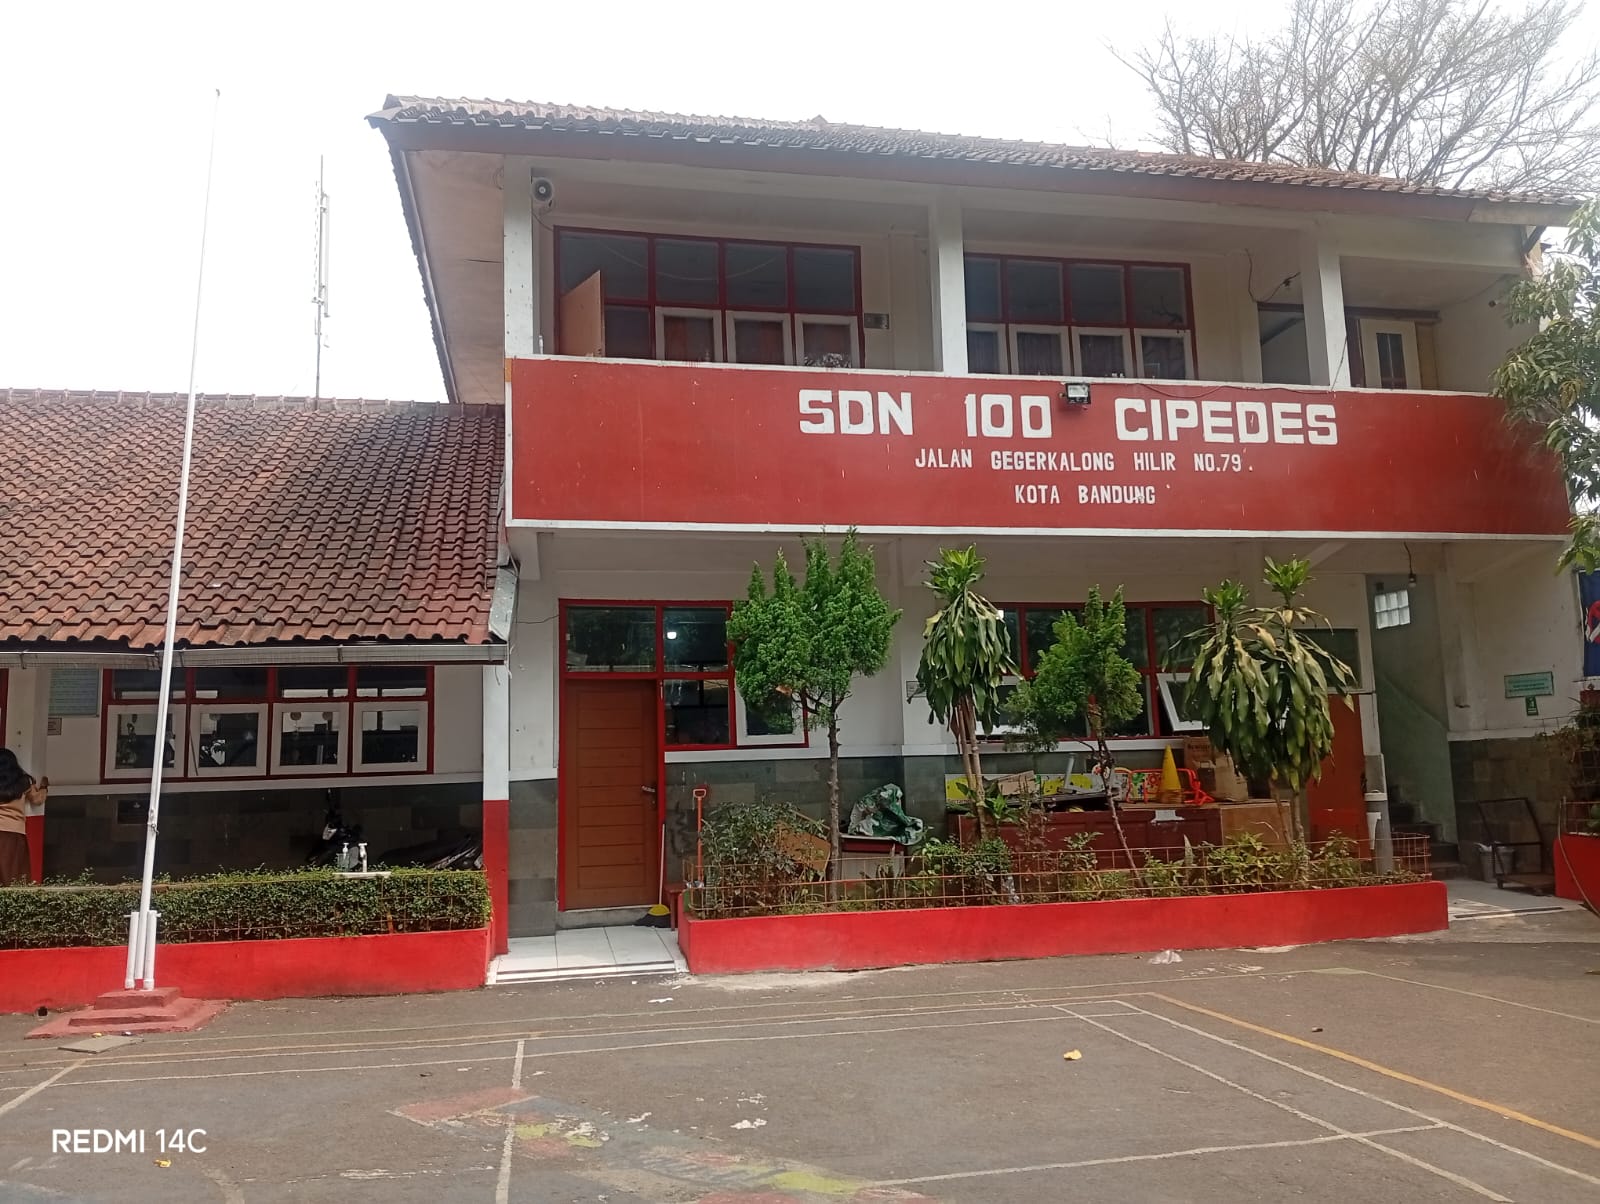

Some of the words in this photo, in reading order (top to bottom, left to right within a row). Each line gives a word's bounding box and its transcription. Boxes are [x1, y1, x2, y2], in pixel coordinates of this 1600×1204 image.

[799, 389, 913, 435] SDN
[964, 393, 1052, 438] 100
[1115, 398, 1338, 445] CIPEDES
[915, 448, 972, 468] JALAN
[991, 451, 1115, 471] GEGERKALONG
[1133, 452, 1176, 471] HILIR
[1015, 485, 1060, 504] KOTA
[1078, 485, 1156, 504] BANDUNG
